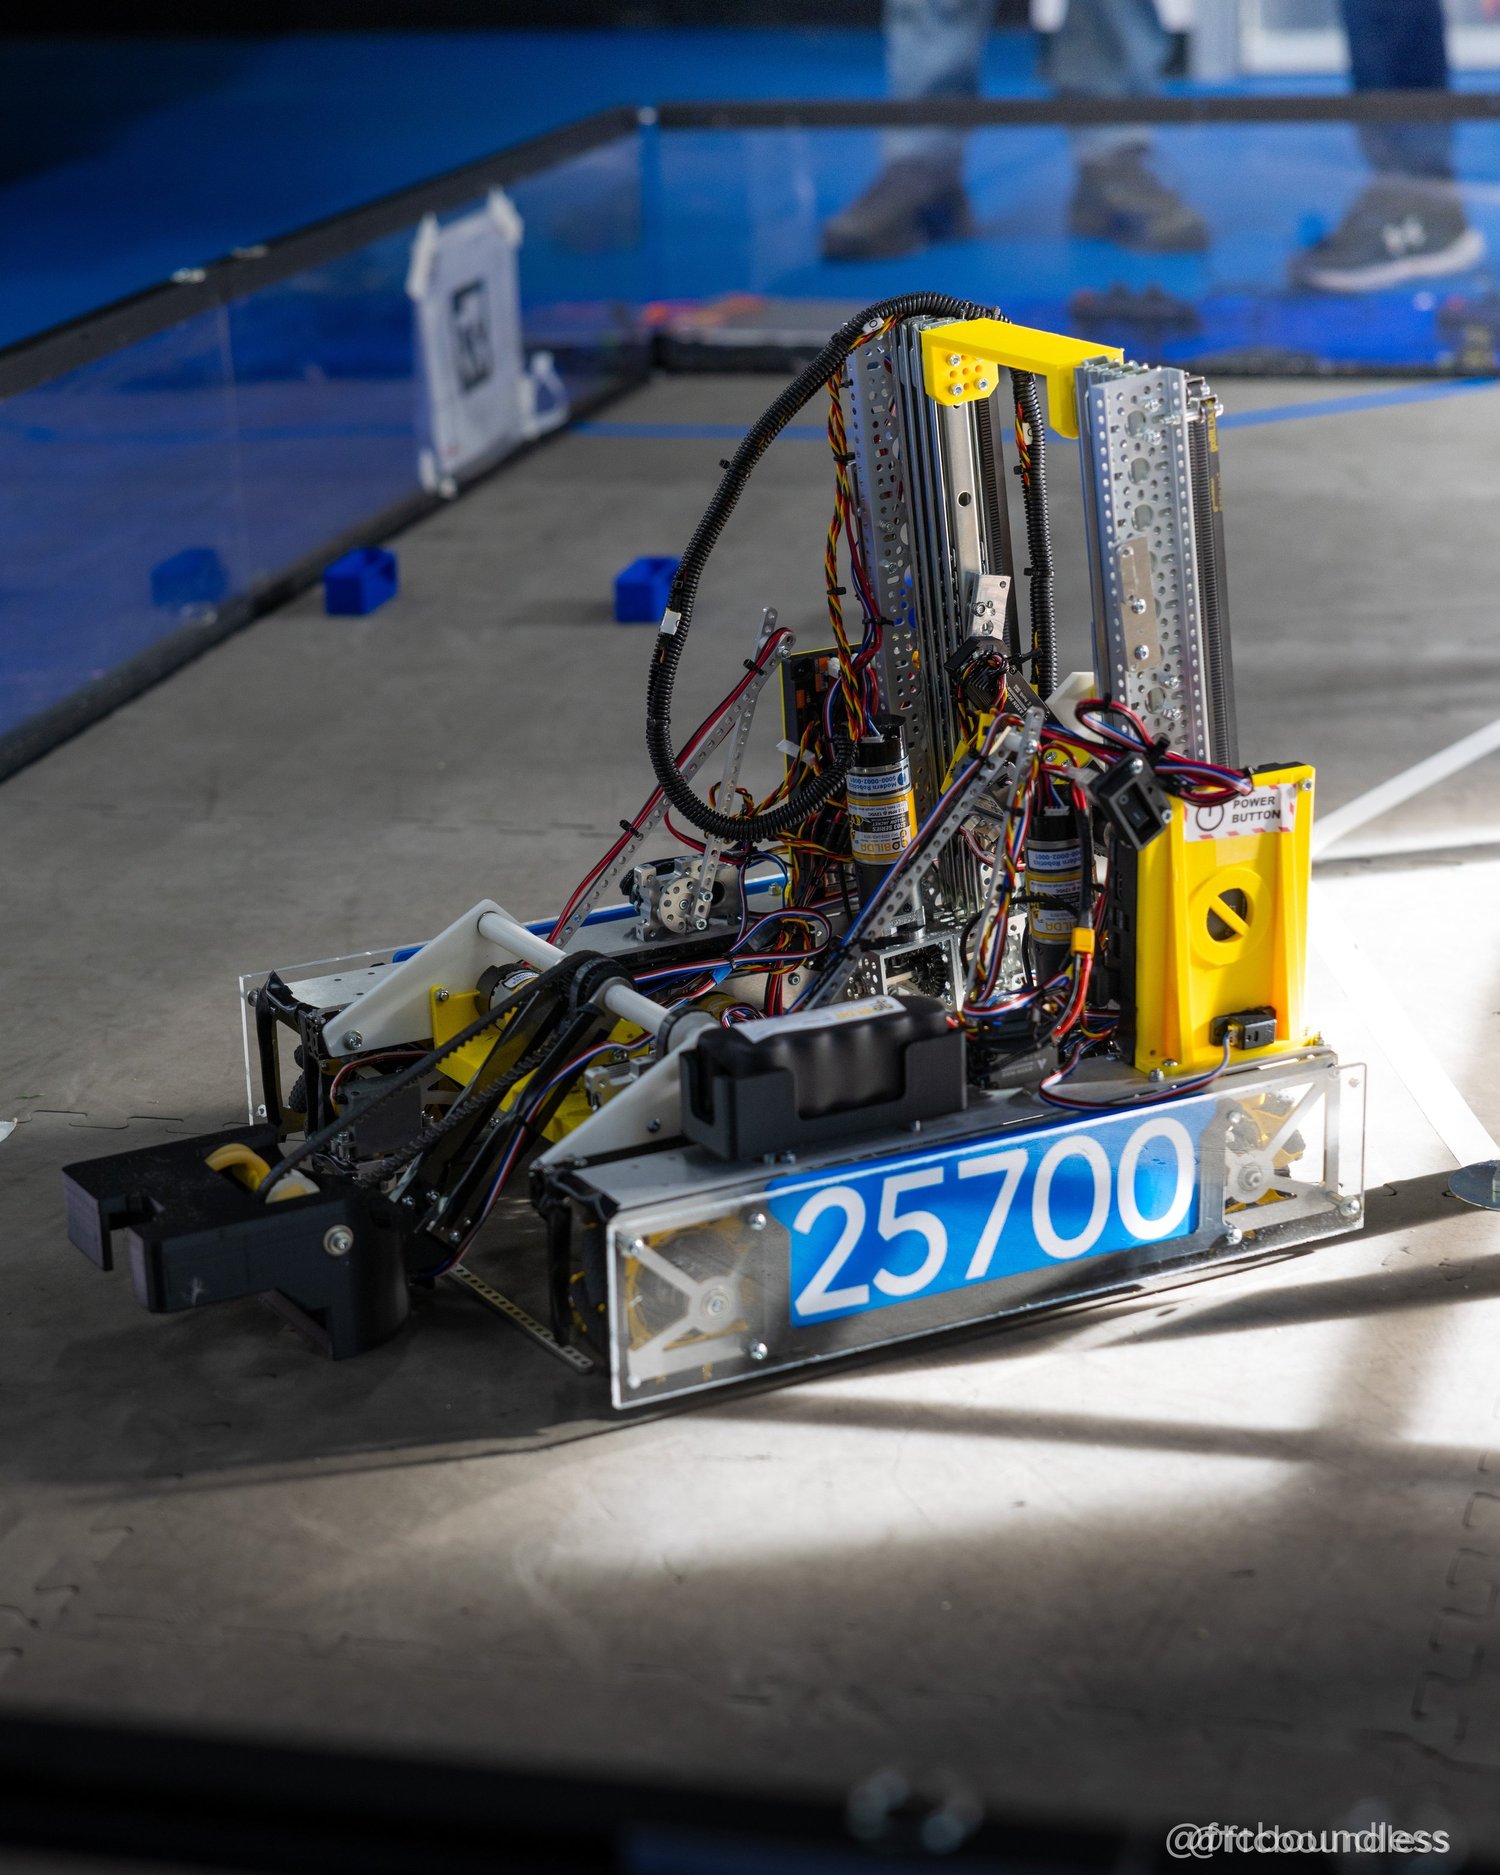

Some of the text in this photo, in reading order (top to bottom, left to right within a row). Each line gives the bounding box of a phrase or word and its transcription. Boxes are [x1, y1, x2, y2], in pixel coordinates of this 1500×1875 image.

[873, 782, 897, 790] Modern
[1233, 796, 1276, 809] POWER
[1232, 810, 1281, 823] BUTTON
[1033, 859, 1061, 868] Robotics
[793, 1116, 1196, 1314] 25700
